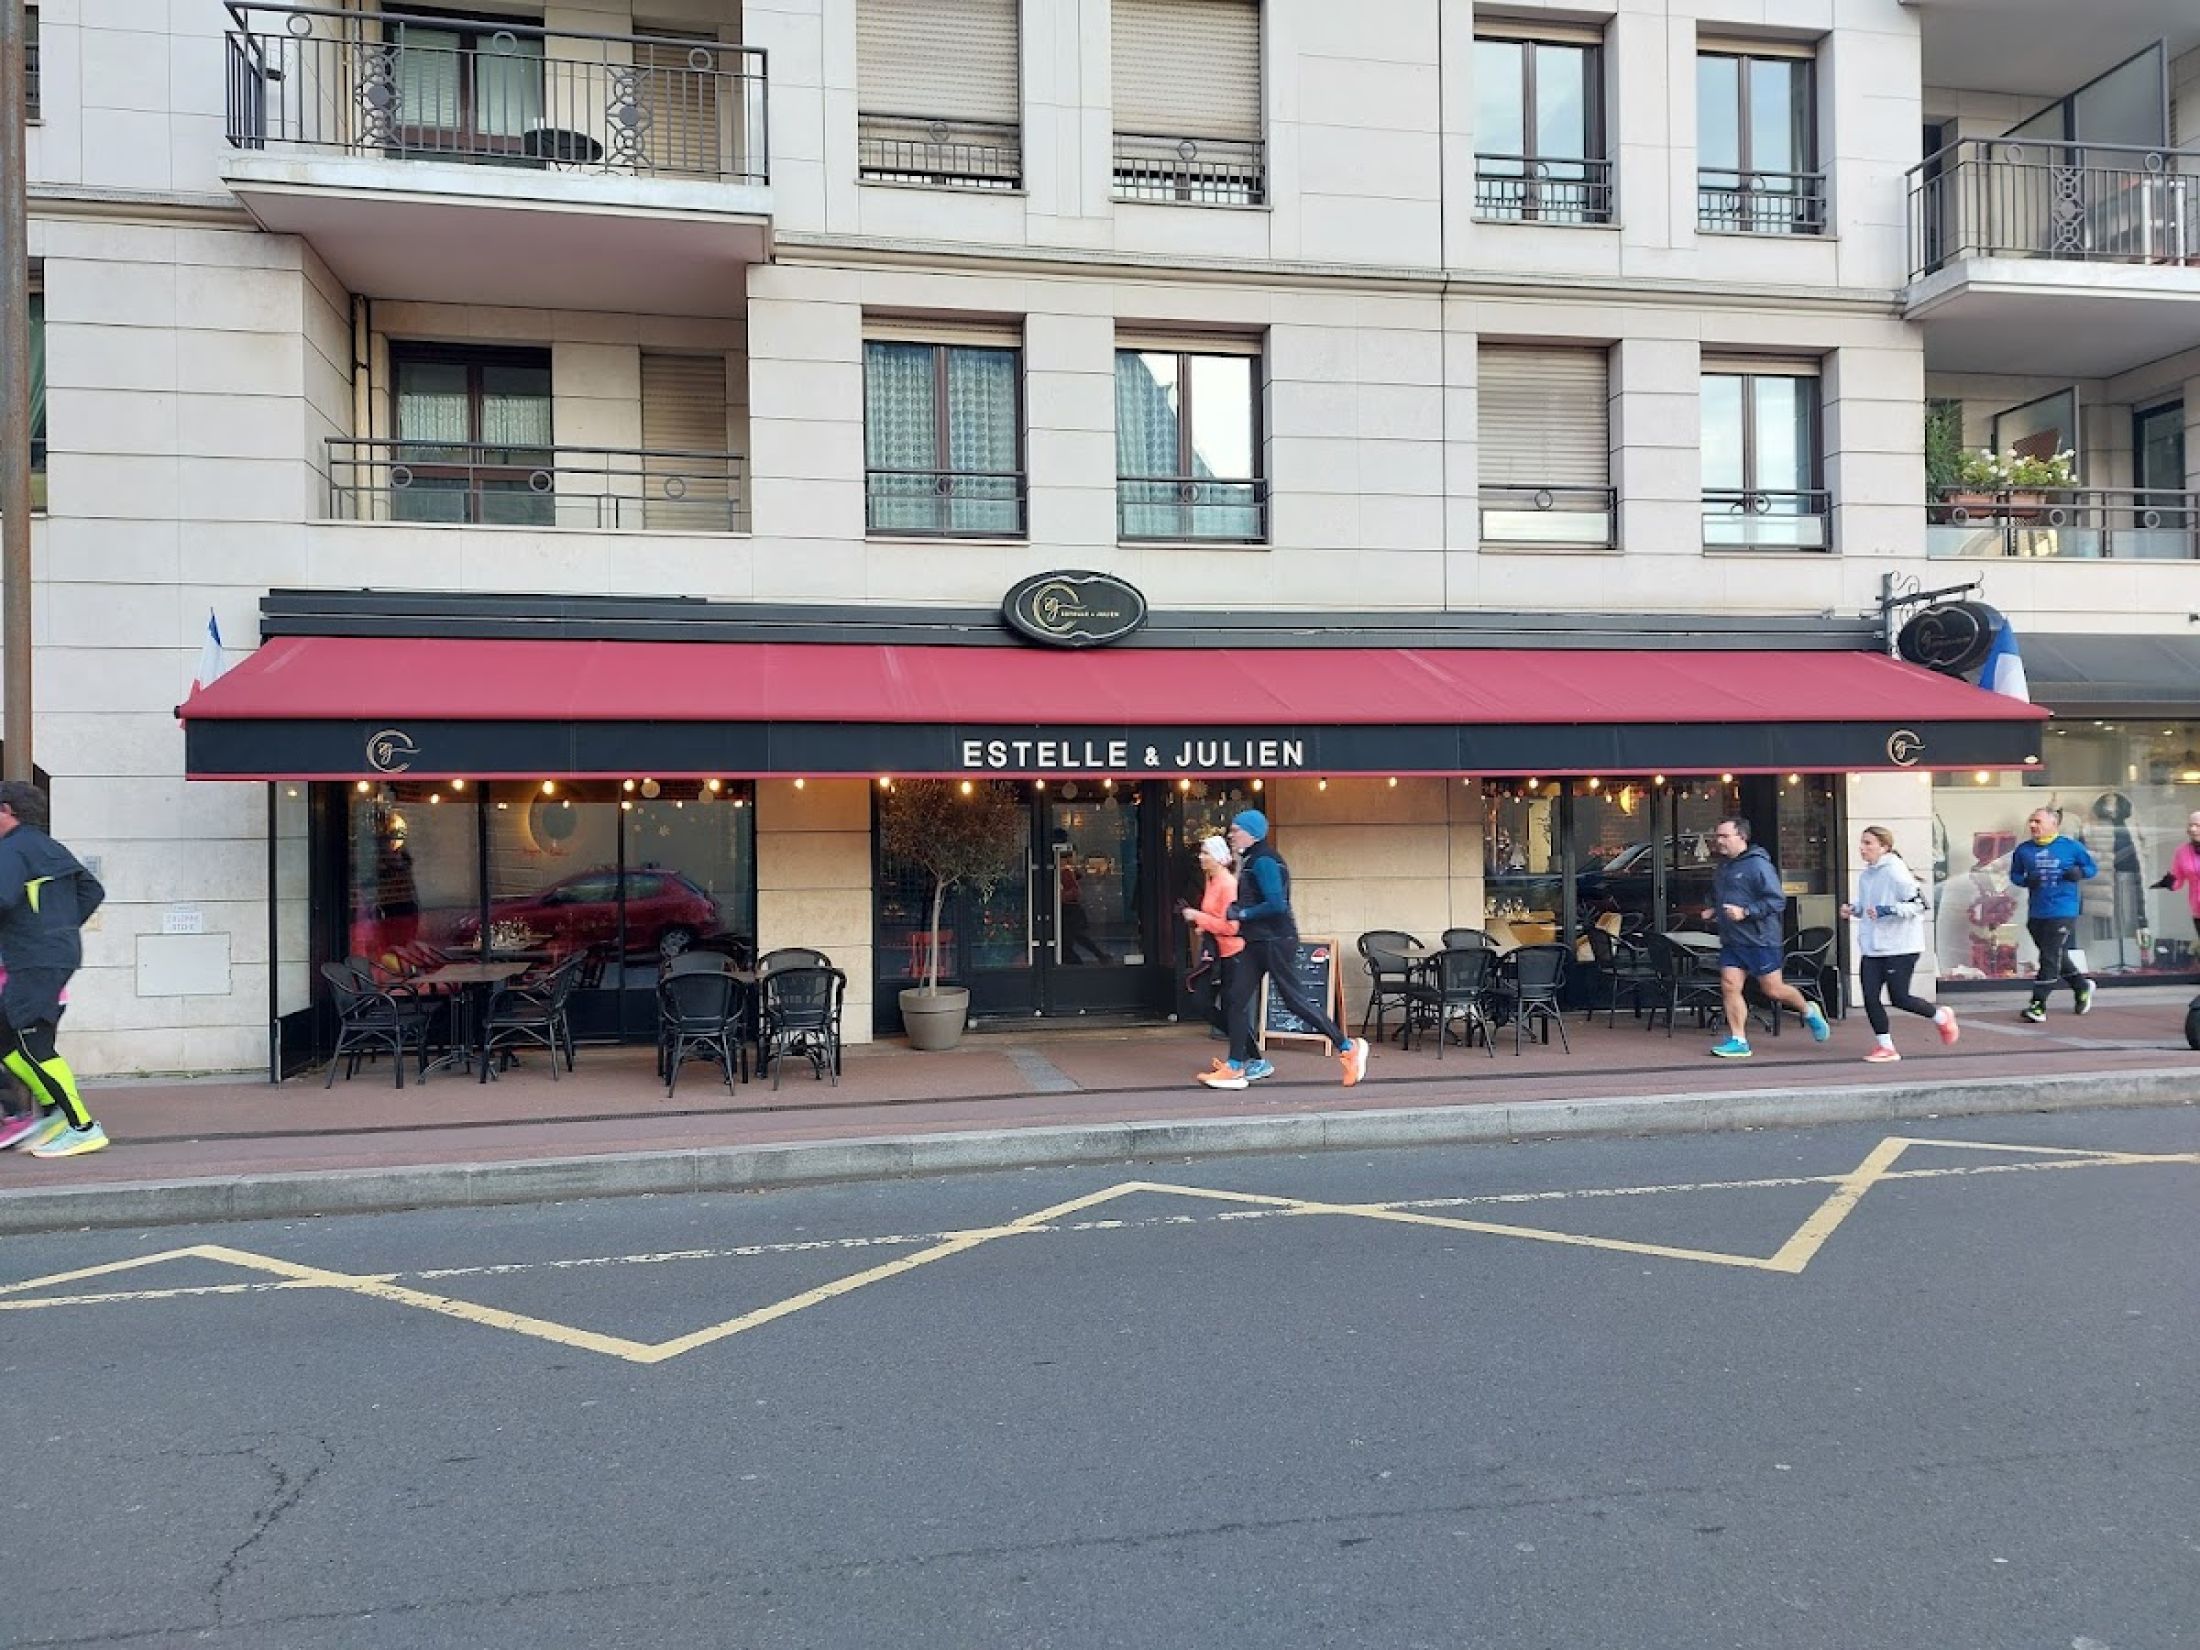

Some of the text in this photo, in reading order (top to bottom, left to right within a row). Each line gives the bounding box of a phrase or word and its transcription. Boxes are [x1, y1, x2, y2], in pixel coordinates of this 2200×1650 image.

[962, 740, 1304, 767] ESTELLE & JULIEN
